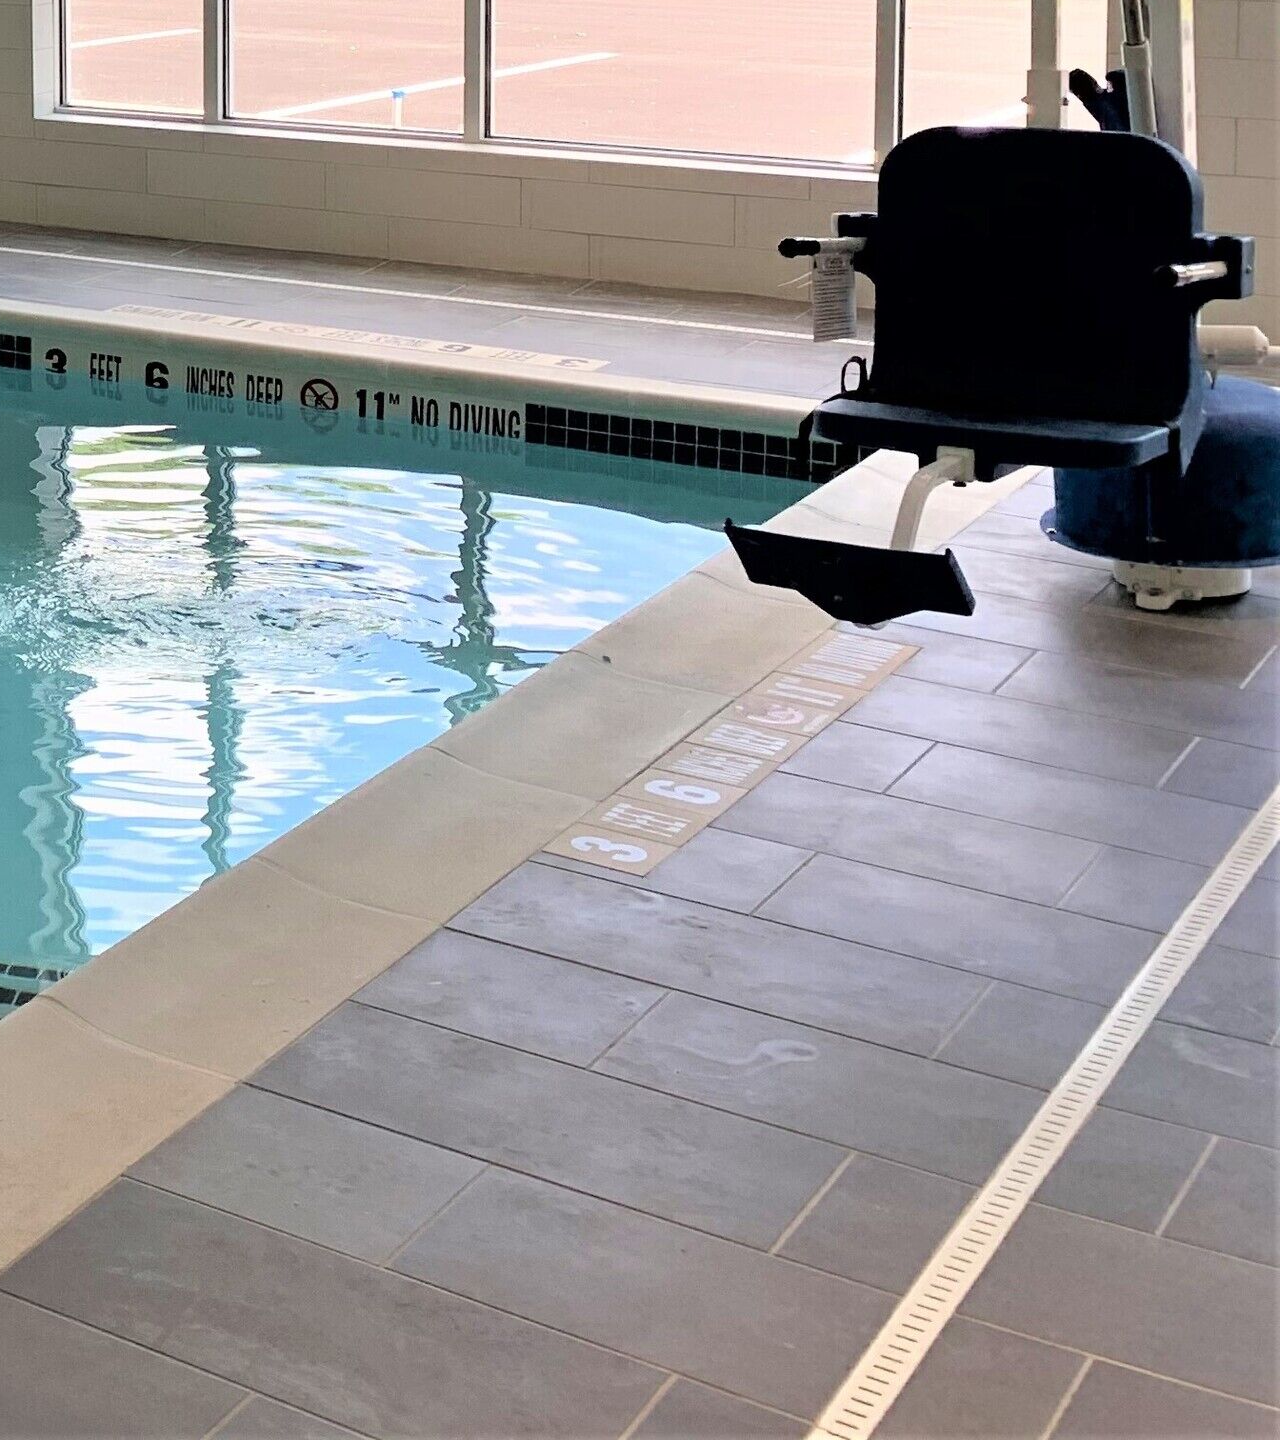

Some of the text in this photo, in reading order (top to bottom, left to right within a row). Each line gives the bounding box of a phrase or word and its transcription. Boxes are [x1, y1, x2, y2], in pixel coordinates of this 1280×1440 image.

[45, 348, 67, 374] 3
[90, 352, 123, 383] FEET
[145, 361, 170, 390] 6
[186, 365, 236, 399] INCHES
[246, 374, 284, 405] DEEP
[411, 395, 439, 428] NO
[449, 401, 521, 439] DIVING
[644, 778, 721, 805] 6
[600, 802, 693, 838] FEET
[571, 835, 648, 863] 3
